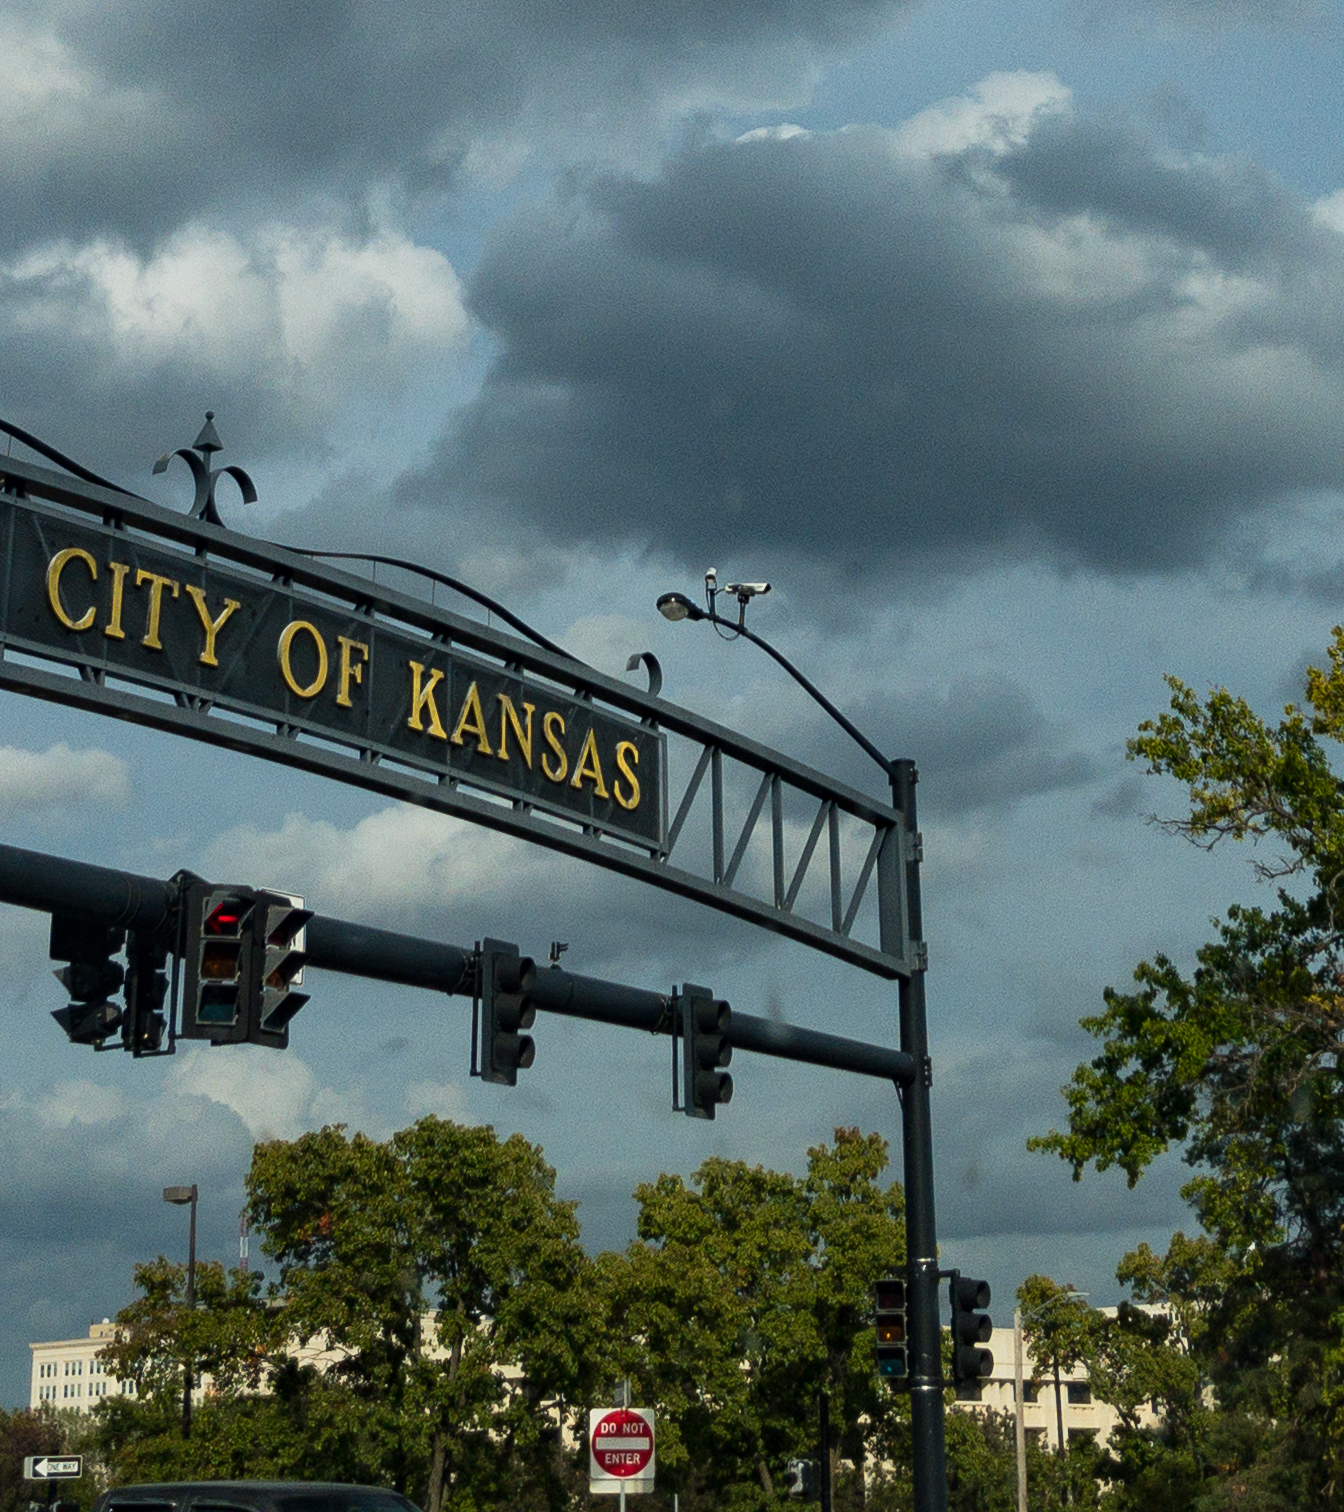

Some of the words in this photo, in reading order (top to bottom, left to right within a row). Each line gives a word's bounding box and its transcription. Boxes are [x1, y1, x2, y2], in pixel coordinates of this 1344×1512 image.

[45, 547, 241, 666] CITY
[277, 620, 370, 707] OF
[407, 661, 642, 811] KANSAS
[600, 1422, 617, 1434] DO
[622, 1422, 645, 1434] NOT
[604, 1452, 641, 1465] ENTER
